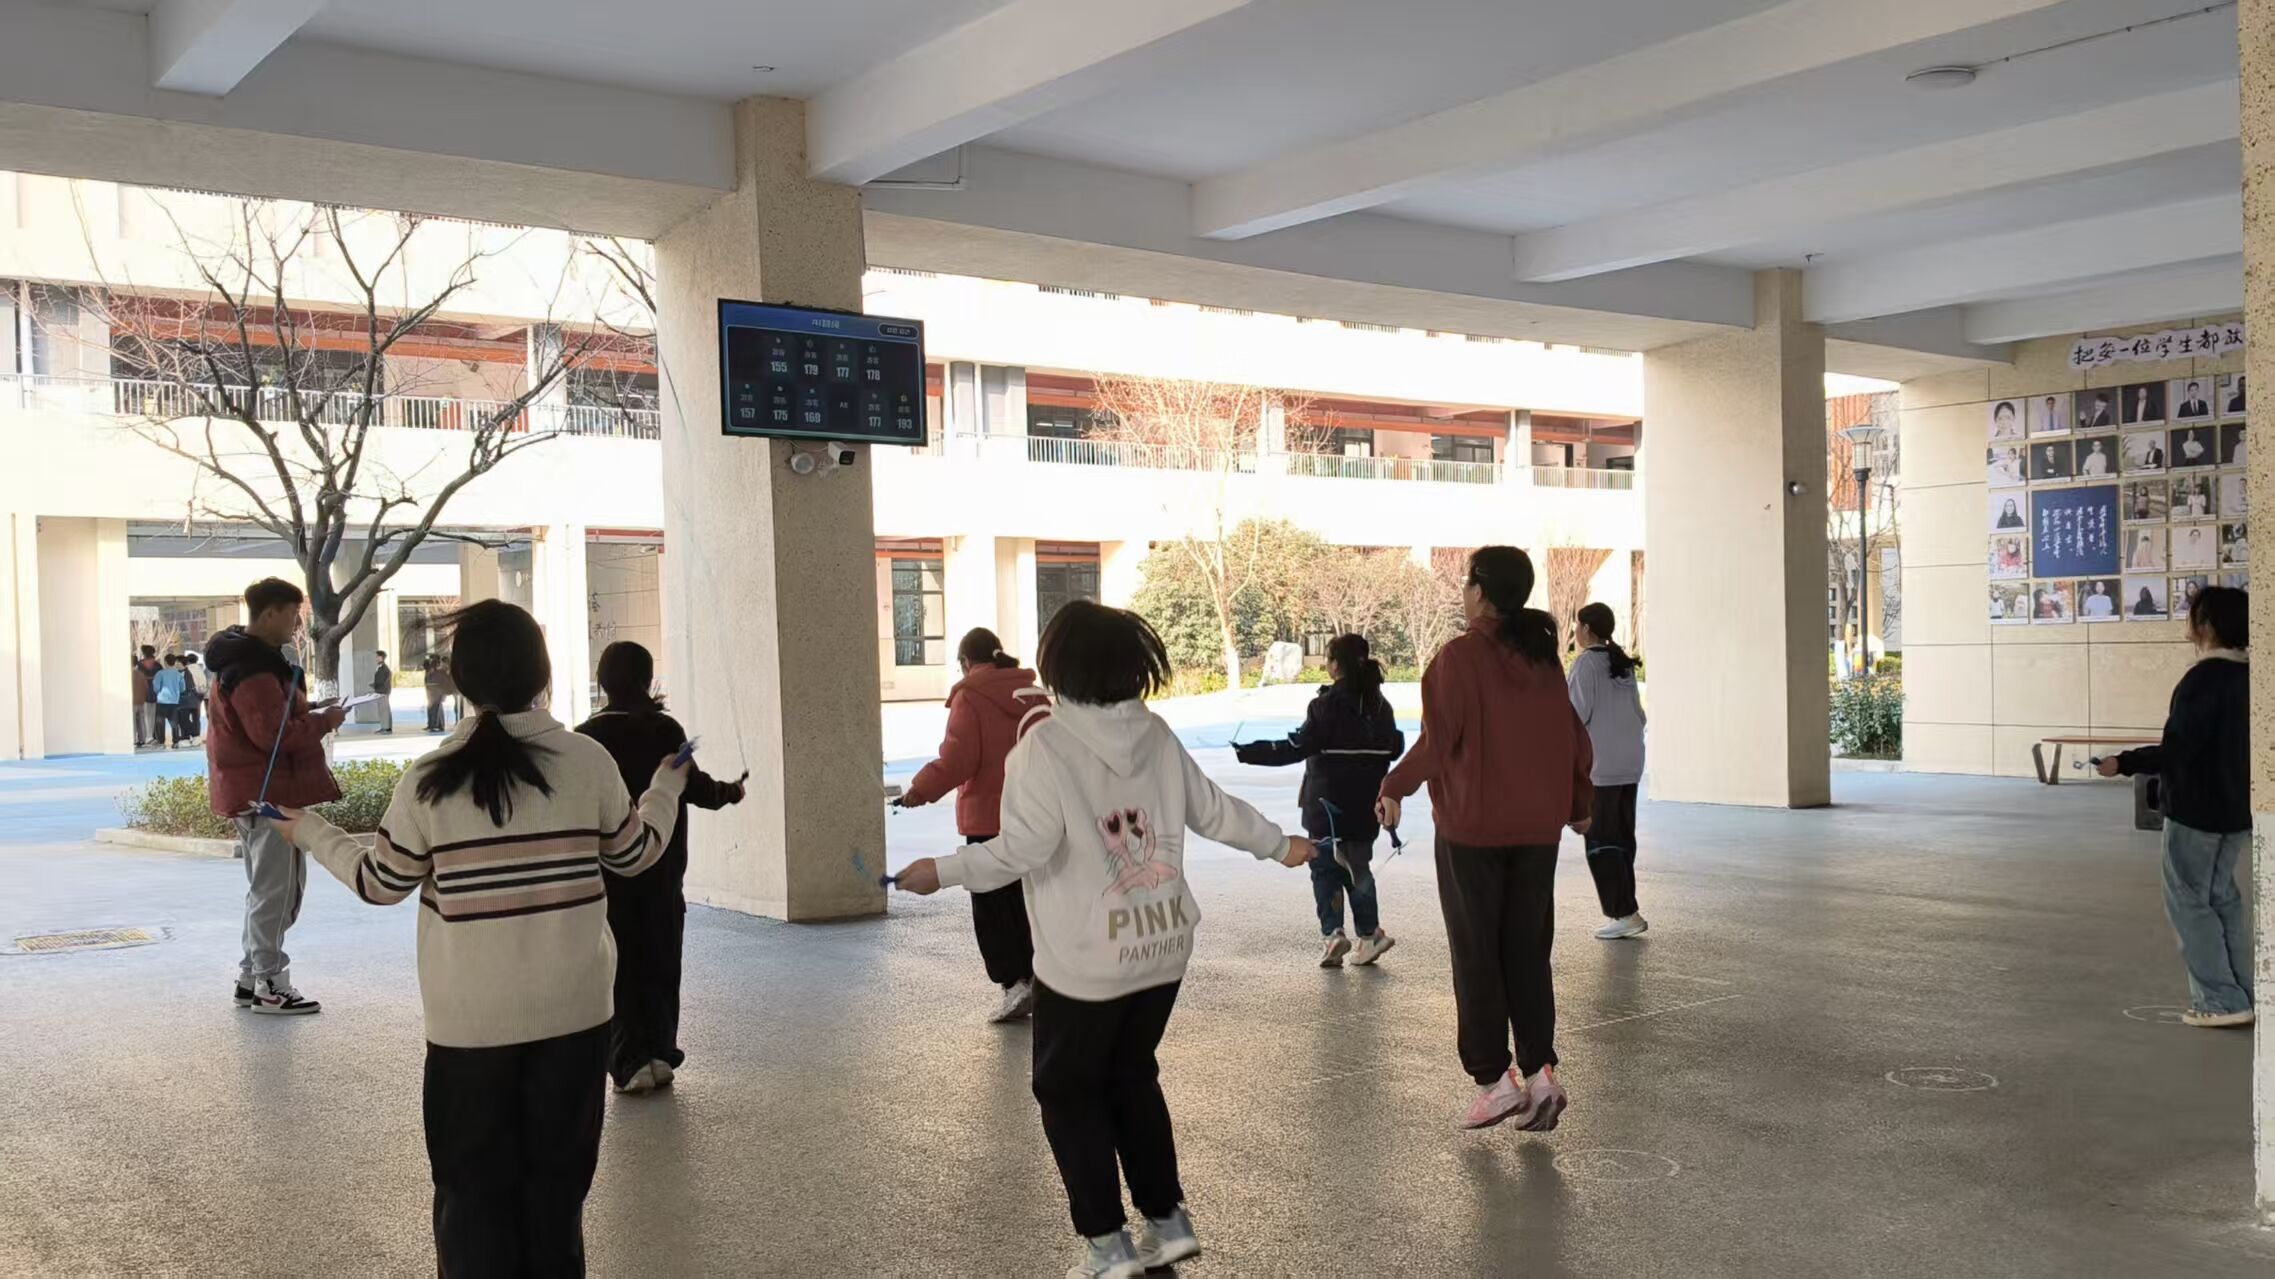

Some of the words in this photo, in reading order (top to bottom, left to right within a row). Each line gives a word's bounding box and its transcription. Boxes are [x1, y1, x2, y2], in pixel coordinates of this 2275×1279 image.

[771, 361, 788, 373] 155
[804, 364, 819, 376] 179
[836, 366, 850, 378] 177
[866, 369, 881, 381] 178
[740, 407, 756, 419] 157
[773, 409, 788, 421] 175
[804, 411, 821, 423] 169
[868, 416, 881, 428] 177
[897, 418, 912, 430] 193
[1107, 895, 1189, 941] PINK
[1119, 935, 1185, 964] PANTHER
